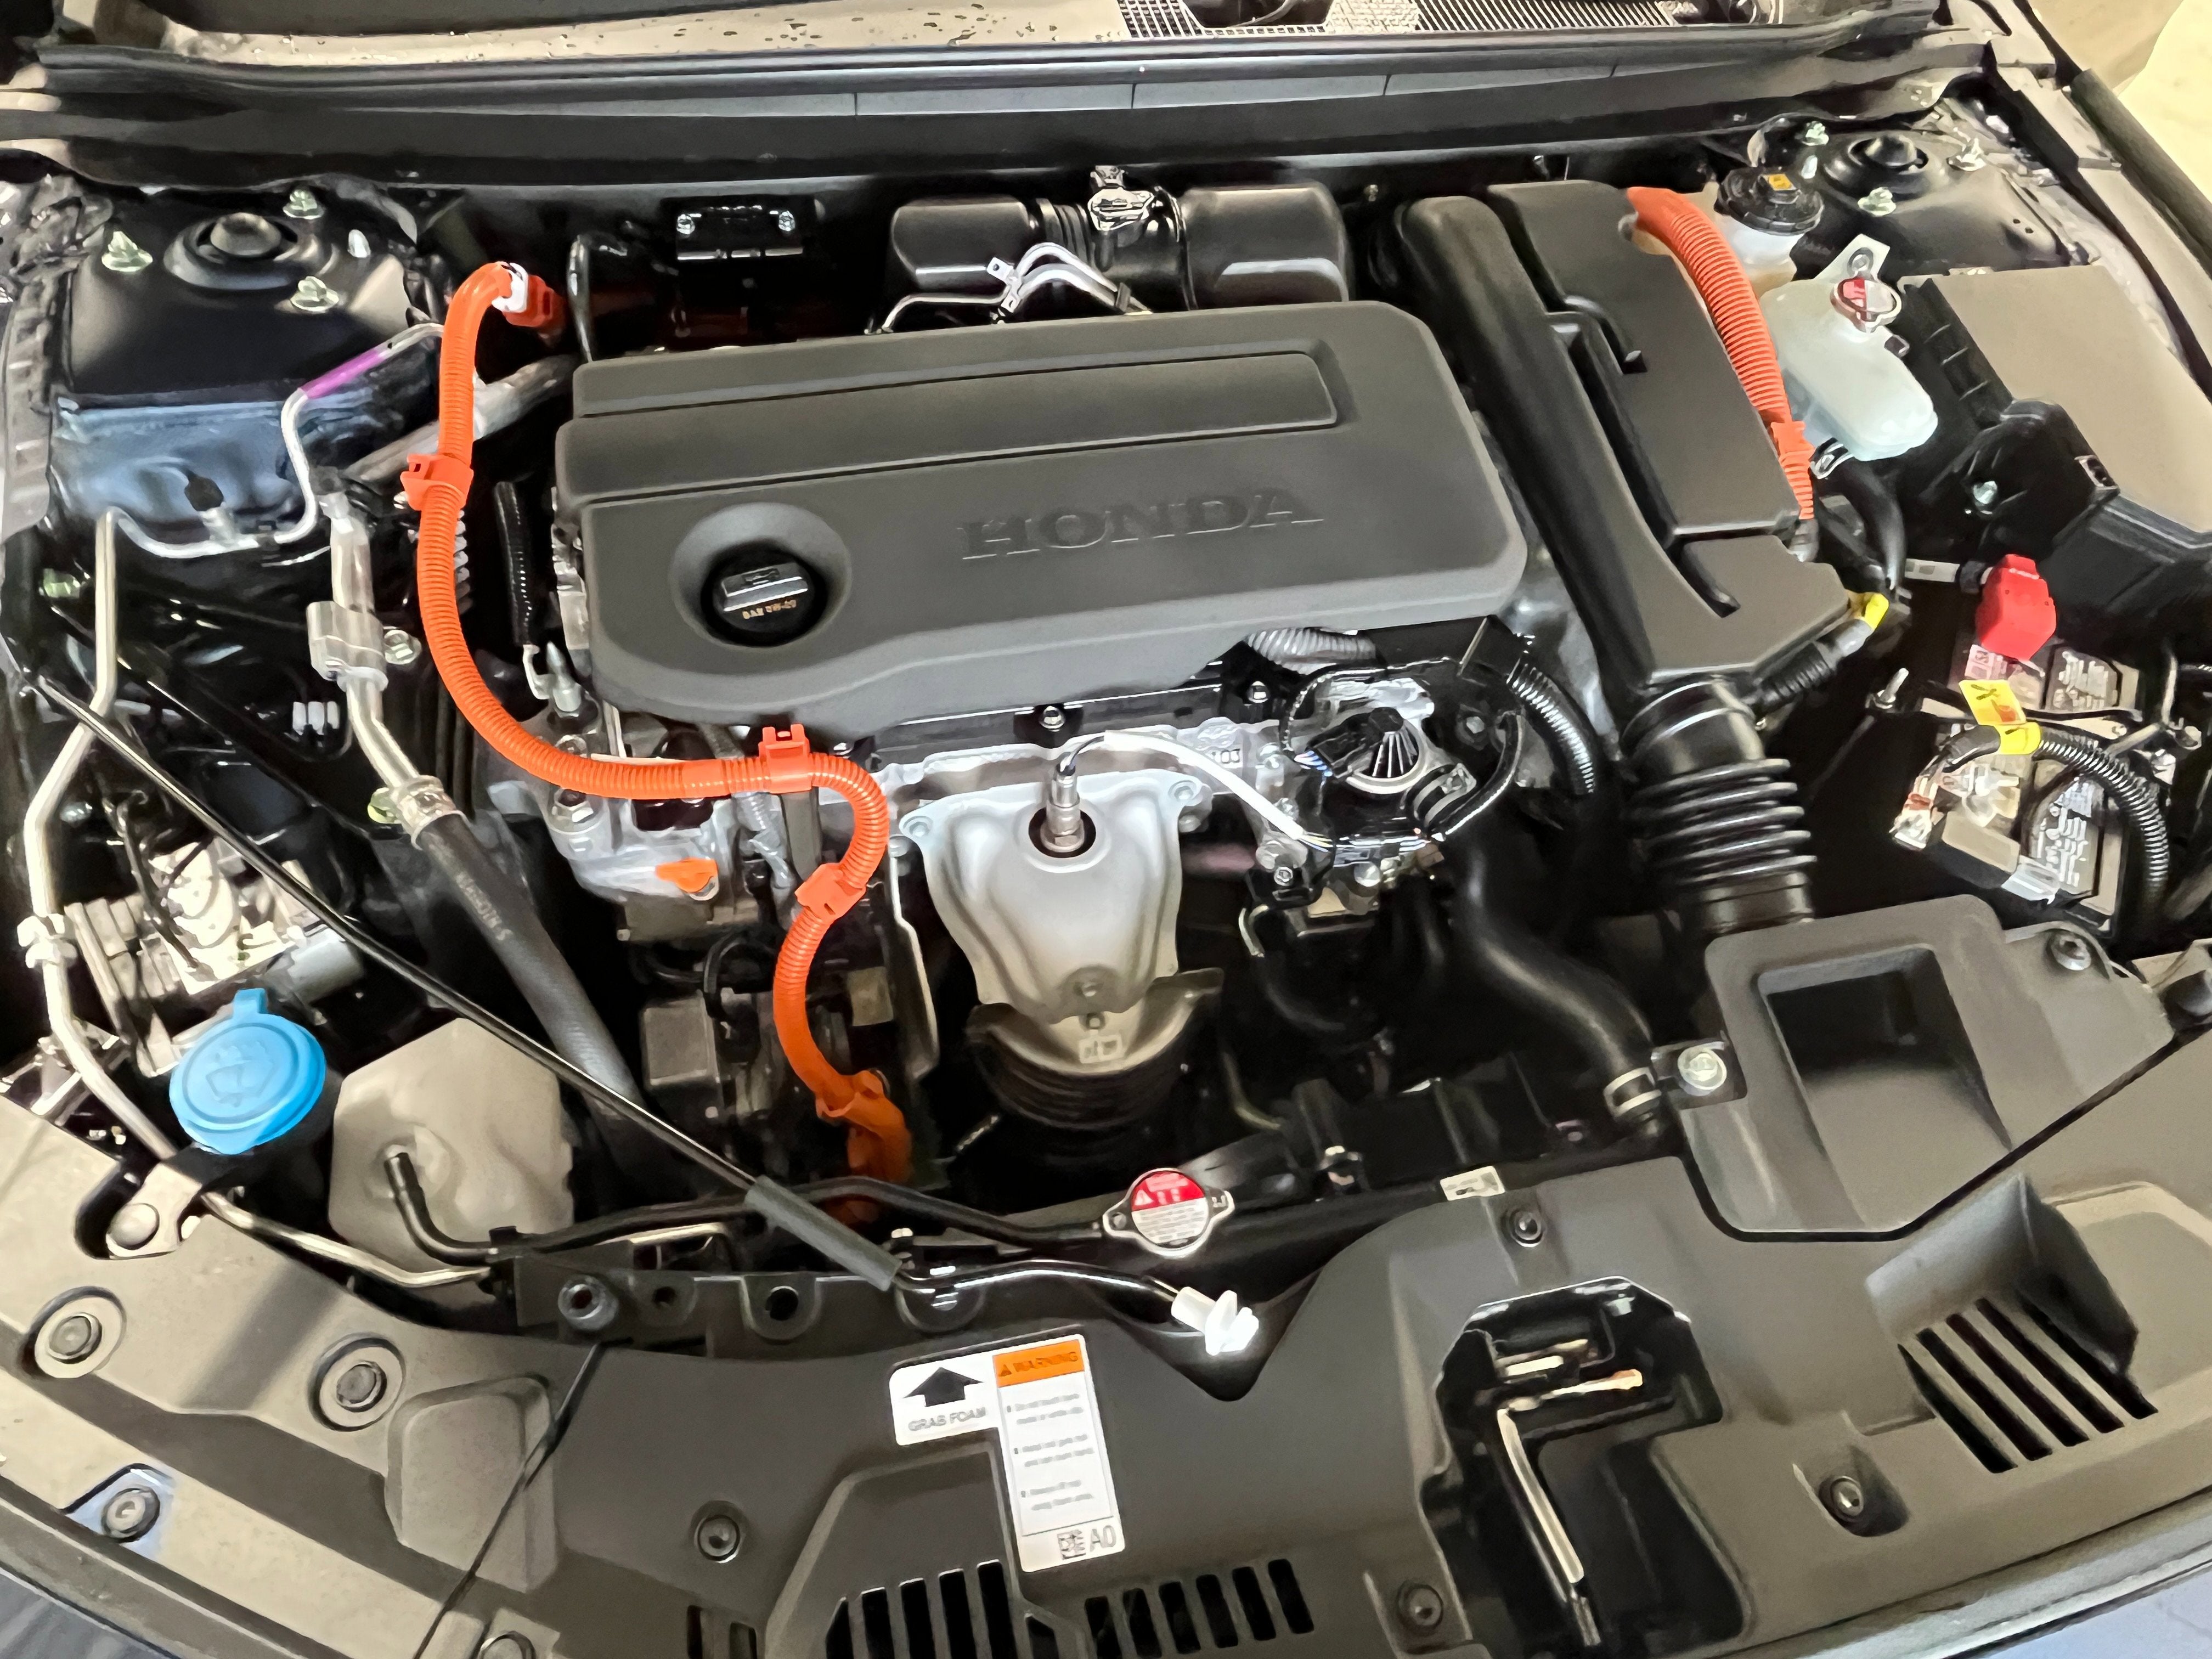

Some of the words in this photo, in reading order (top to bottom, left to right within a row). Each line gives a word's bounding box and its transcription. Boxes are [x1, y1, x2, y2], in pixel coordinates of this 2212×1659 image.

[956, 490, 1324, 560] HONDA
[908, 1415, 947, 1431] GRAB
[950, 1407, 986, 1424] FOAM
